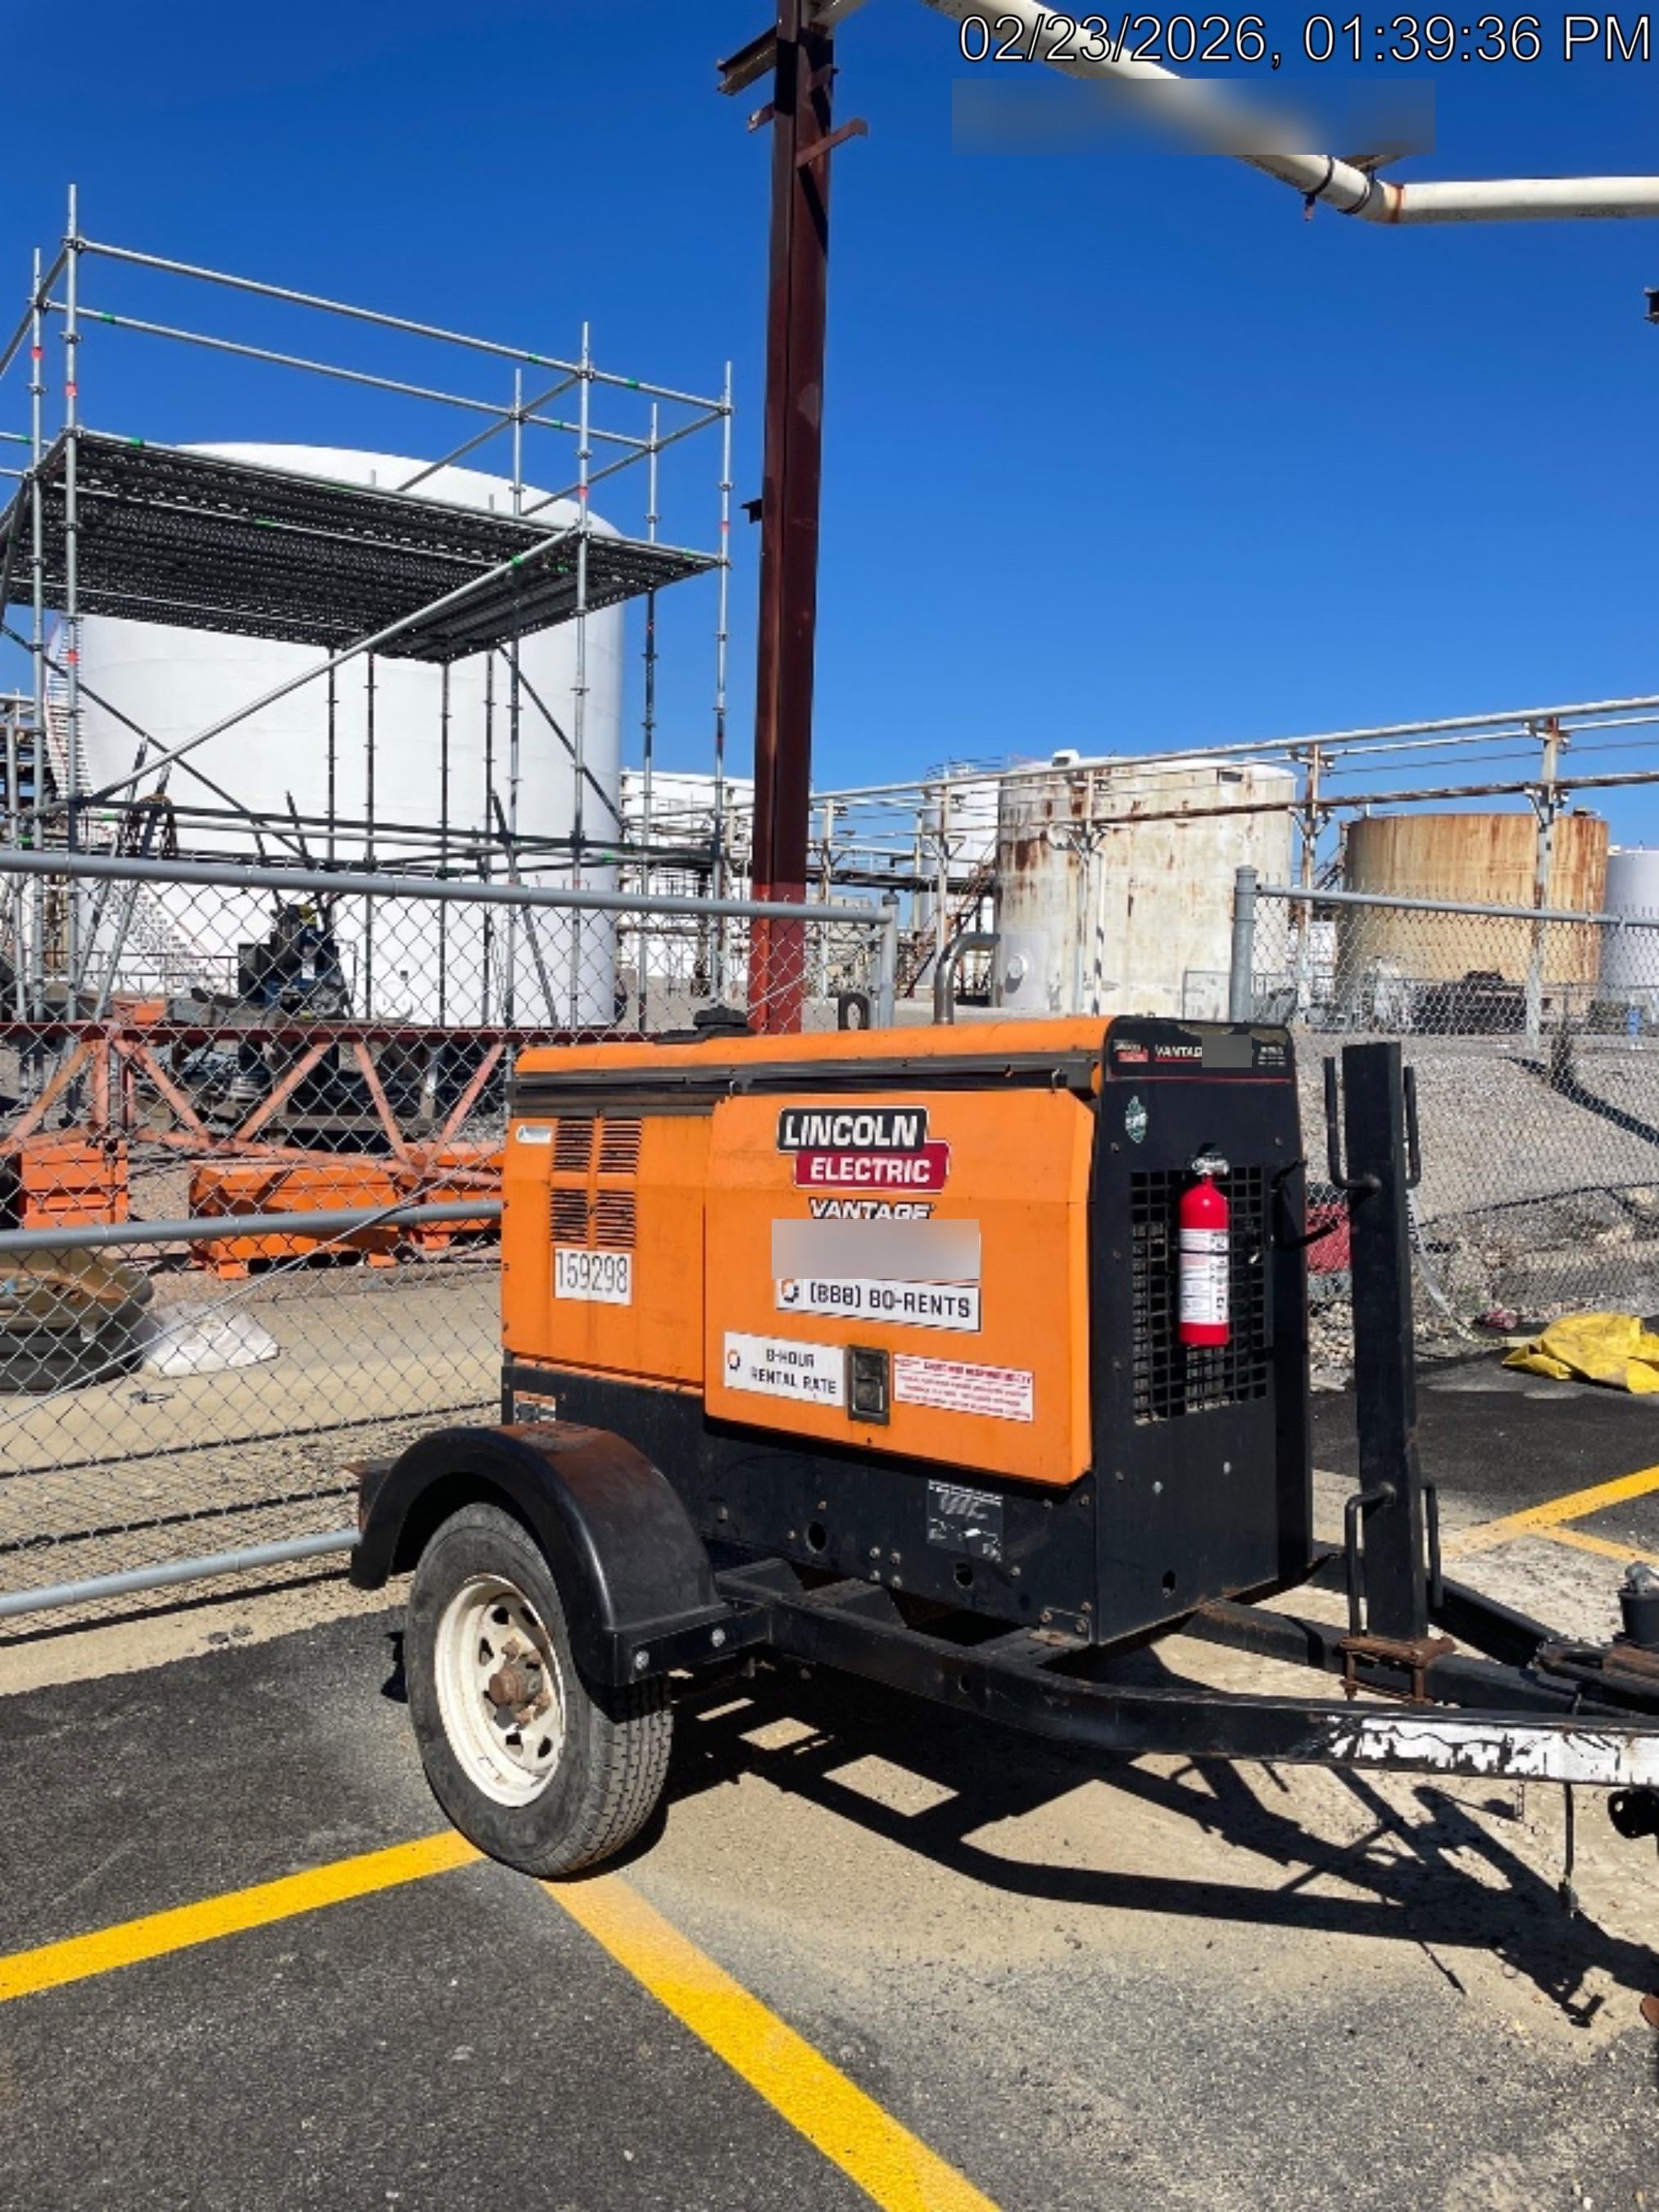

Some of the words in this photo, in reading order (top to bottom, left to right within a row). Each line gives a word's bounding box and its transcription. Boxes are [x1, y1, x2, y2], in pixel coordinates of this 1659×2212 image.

[784, 1115, 918, 1146] LINCOLN
[810, 1157, 931, 1183] ELECTRIC
[809, 1199, 932, 1219] VANTAGE
[555, 1252, 627, 1293] 159298
[751, 1366, 797, 1388] RENTAL
[803, 1376, 836, 1394] RATE
